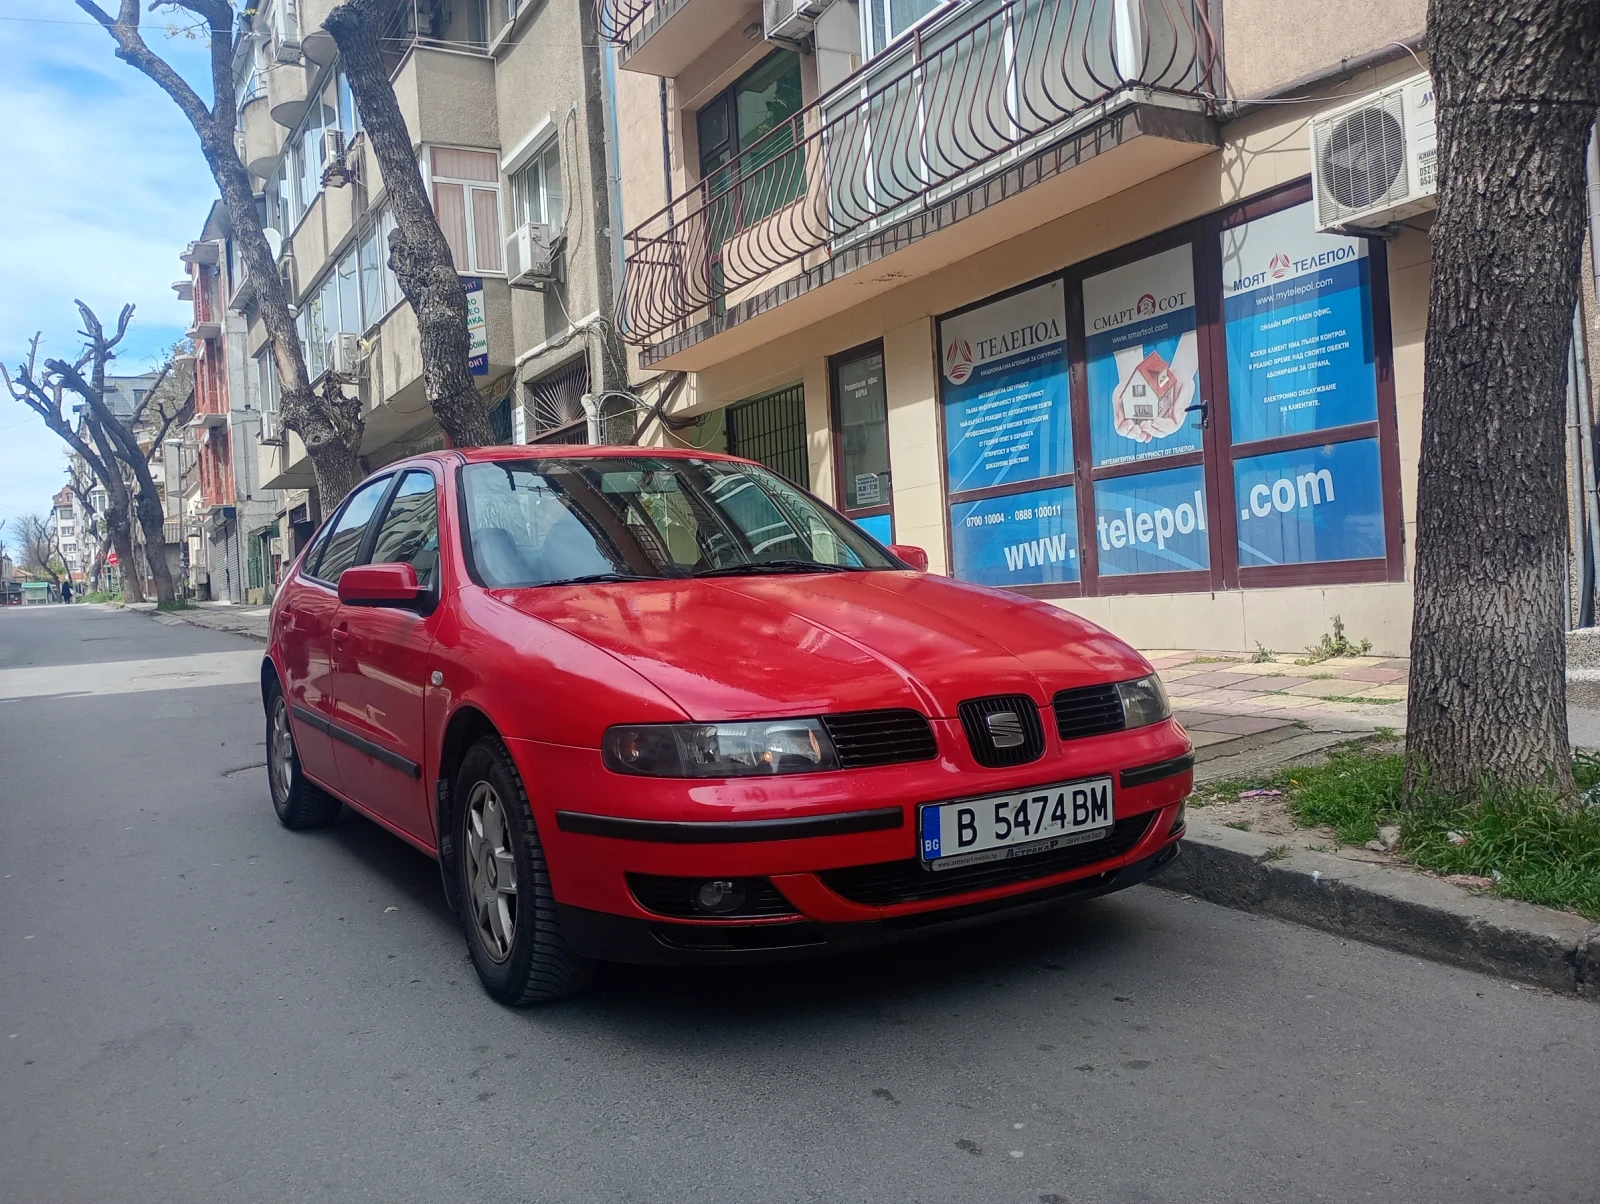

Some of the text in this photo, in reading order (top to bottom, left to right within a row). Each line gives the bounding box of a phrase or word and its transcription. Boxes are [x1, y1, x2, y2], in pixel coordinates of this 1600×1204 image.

[1233, 245, 1356, 292] МОЯТ ТЕЛЕПОЛ
[1255, 276, 1333, 306] www.mytelepol.com
[1093, 292, 1187, 331] СМАРТ СОТ
[1260, 307, 1332, 331] ОНЛАЙН ВИРТУАЛЕН ОФИС,
[976, 318, 1061, 360] ТЕЛЕПОЛ
[1112, 322, 1168, 344] www.smartsot.com
[1250, 329, 1347, 358] ВСЕКИ КЛИЕНТ ИМА ПЪЛЕН КОНТРОЛ
[1036, 348, 1063, 360] СИГУРНОСТ
[1253, 359, 1273, 370] РЕАЛНО
[1273, 355, 1292, 365] ВРЕМЕ
[1292, 352, 1304, 362] НАД
[1304, 347, 1326, 358] СВОИТЕ
[1326, 341, 1350, 353] ОБЕКТИ
[1266, 366, 1298, 379] АБОНИРАНИ
[1307, 359, 1331, 370] ОХРАНА,
[1263, 383, 1337, 404] ЕЛЕКТРОННО ОБСЛУЖВАНЕ
[1280, 404, 1288, 413] НА
[1100, 455, 1135, 466] ИНТЕЛИГЕНТНА
[1135, 450, 1164, 461] СИГУРНОСТ
[1172, 444, 1195, 454] ТЕЛЕПОЛ
[966, 504, 1061, 528] 0700 10004 0888 100011
[1003, 468, 1335, 572] www. telepol .com
[957, 807, 978, 848] B
[925, 839, 940, 852] BG
